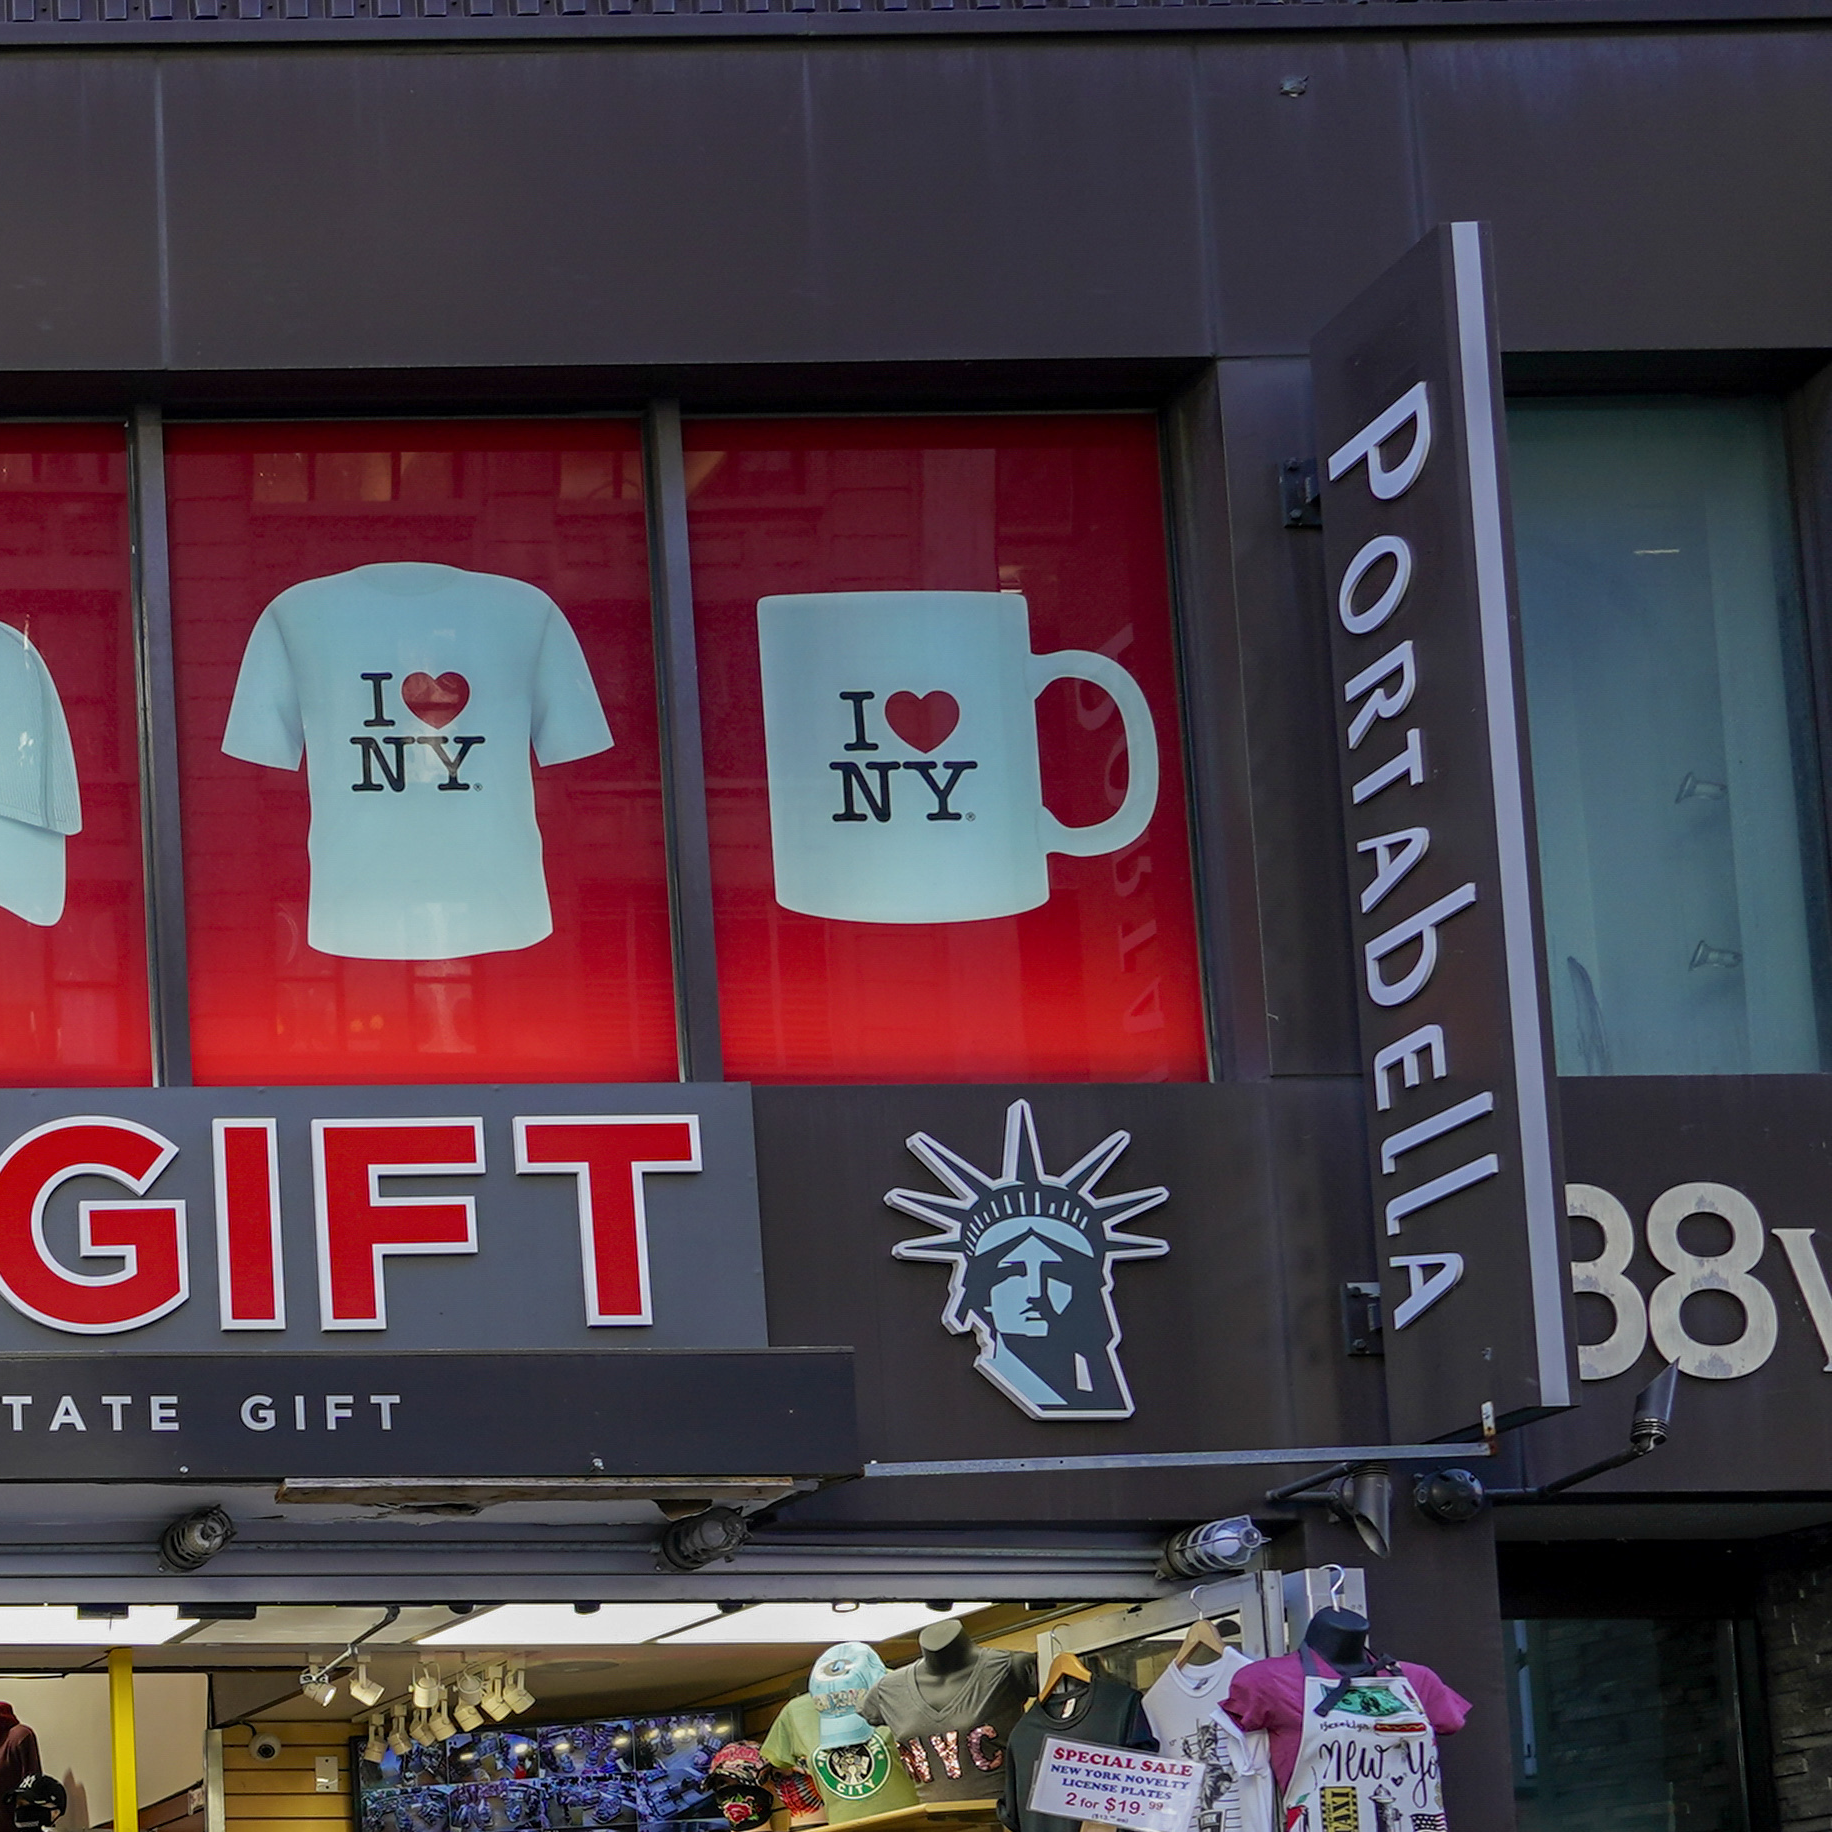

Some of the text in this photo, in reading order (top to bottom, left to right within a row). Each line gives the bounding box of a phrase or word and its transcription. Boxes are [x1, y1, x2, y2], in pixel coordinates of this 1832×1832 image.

[361, 672, 396, 728] I
[839, 690, 878, 751] I
[350, 736, 485, 793] NY
[829, 761, 977, 822] NY
[240, 1394, 402, 1431] GIFT
[896, 1724, 1004, 1783] NYC
[1053, 1747, 1193, 1777] SPECIAL SALE
[1319, 1739, 1386, 1782] New
[837, 1779, 875, 1795] CITY
[1050, 1764, 1191, 1790] NEW YORK NOVELTY
[1062, 1778, 1173, 1800] LICENSE PLATES
[1065, 1792, 1078, 1806] 2
[1080, 1798, 1100, 1809] for
